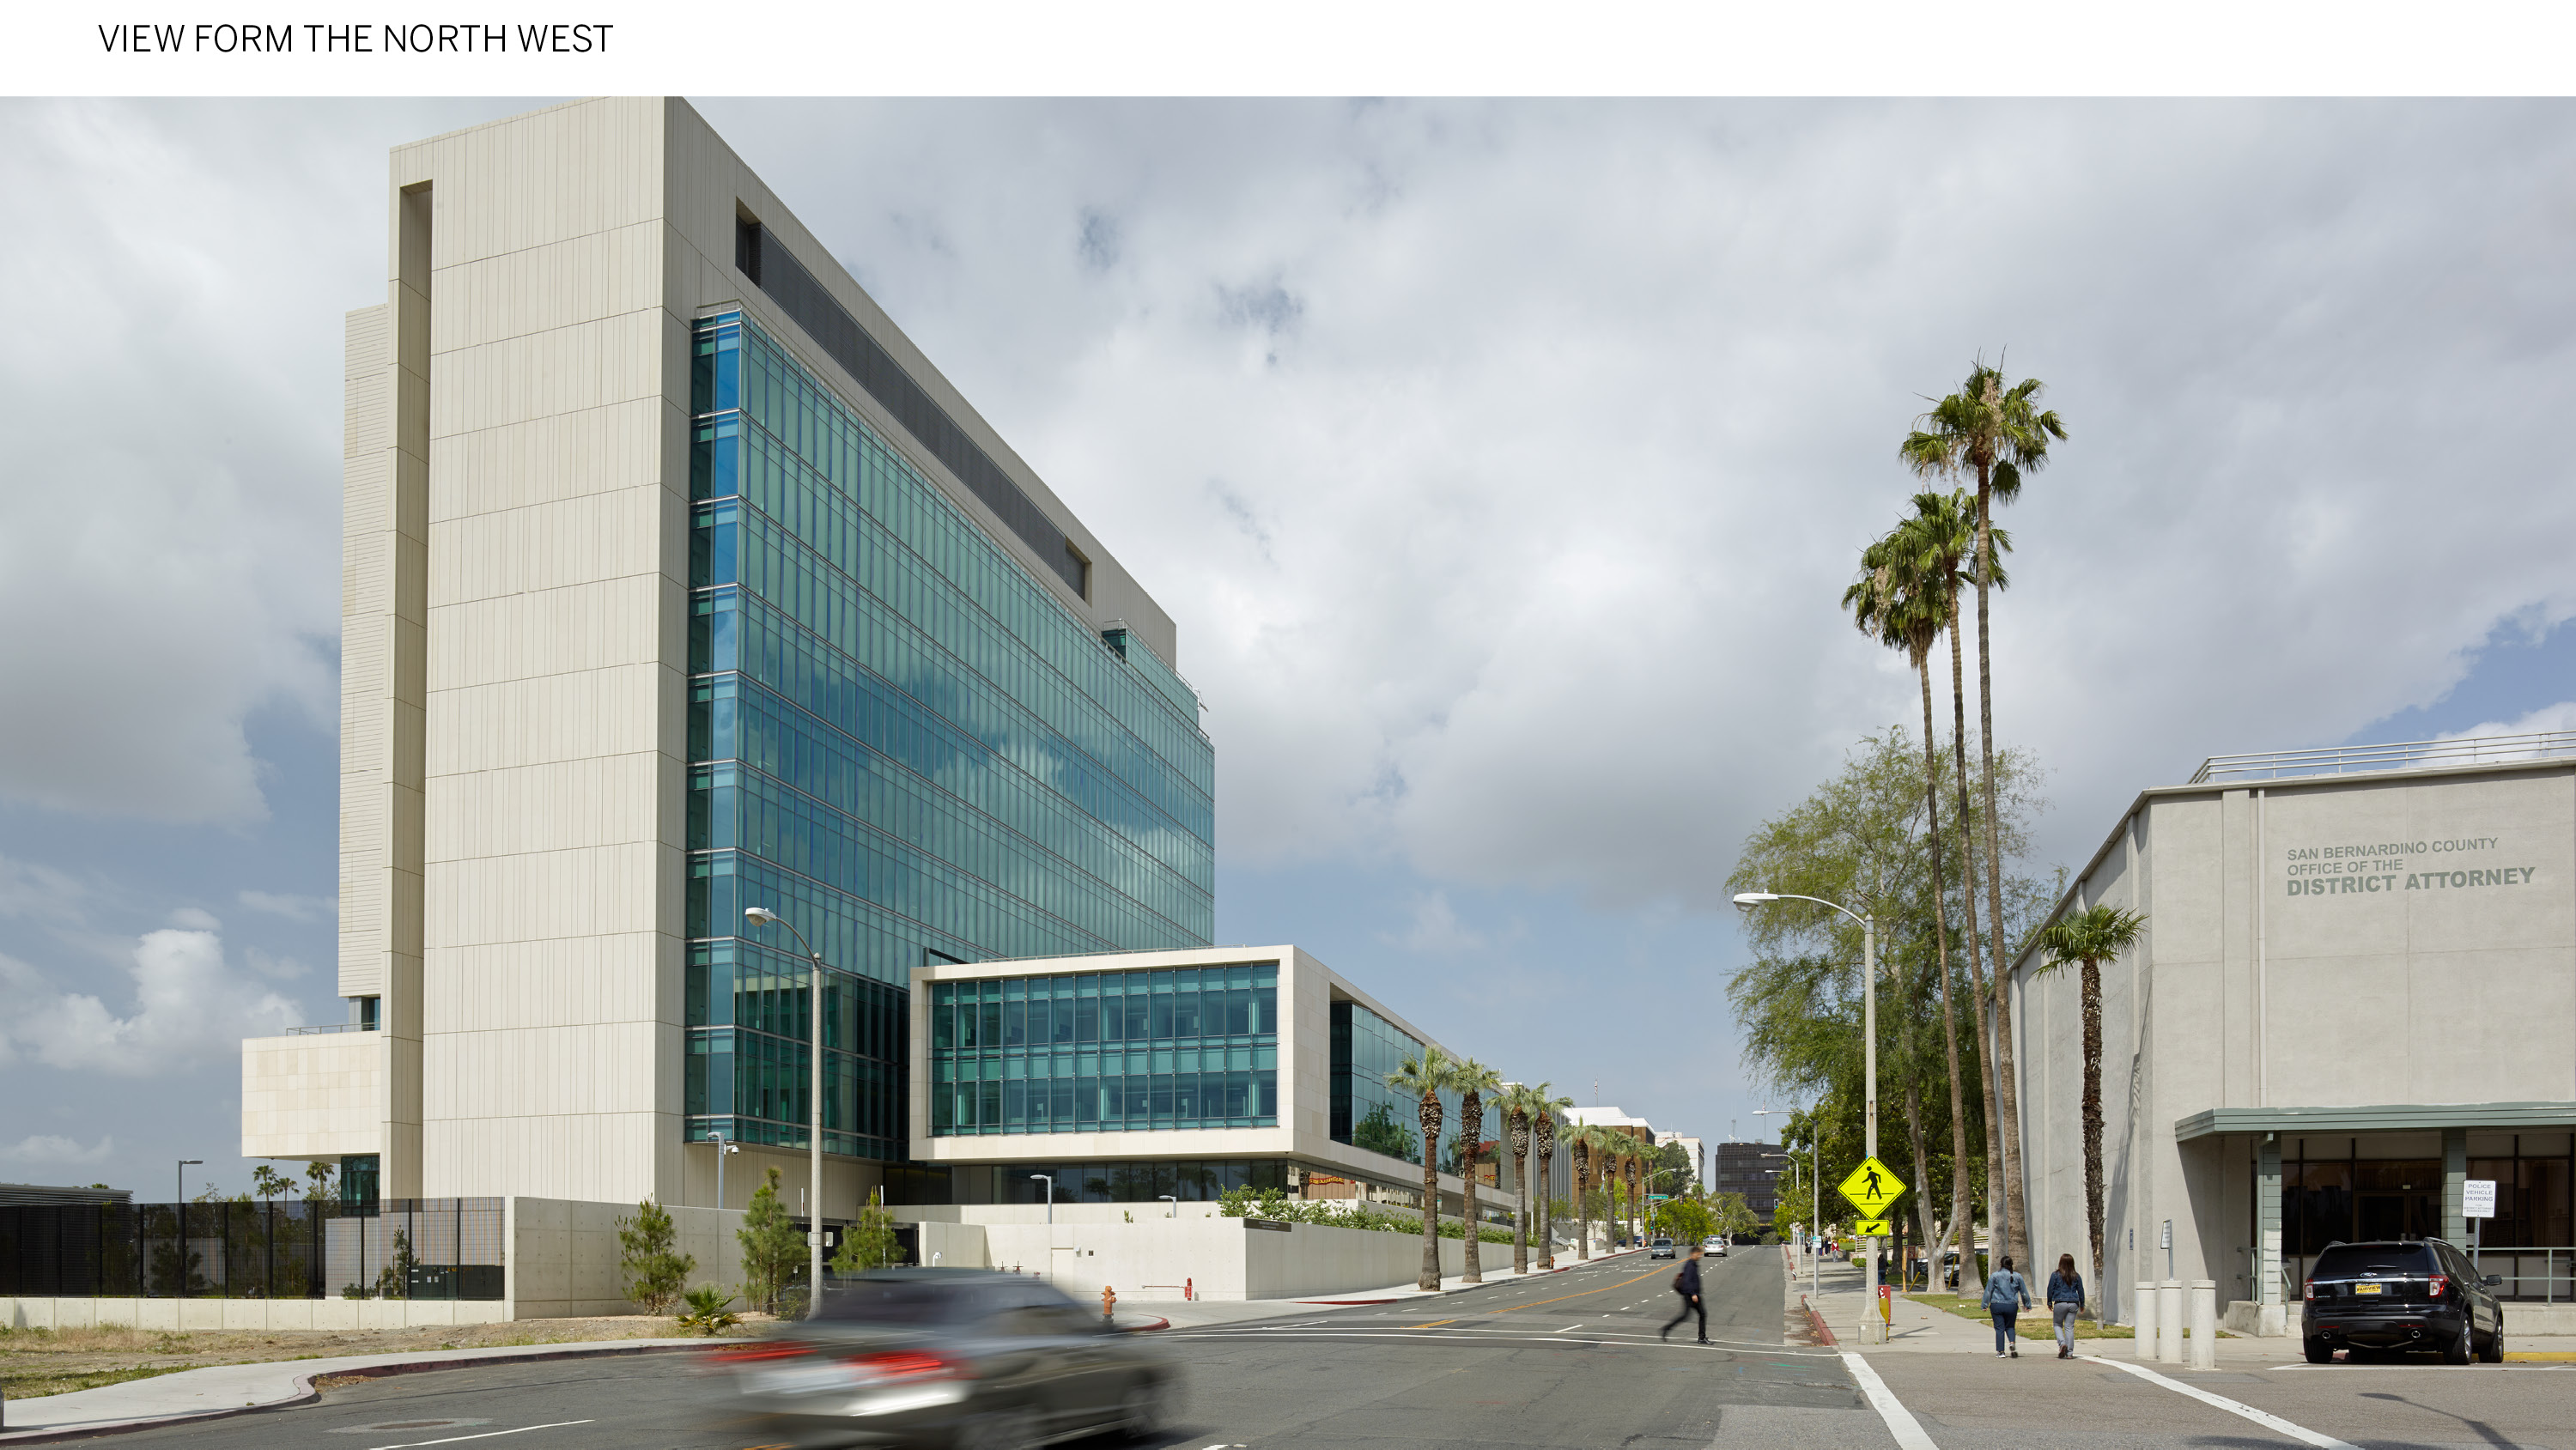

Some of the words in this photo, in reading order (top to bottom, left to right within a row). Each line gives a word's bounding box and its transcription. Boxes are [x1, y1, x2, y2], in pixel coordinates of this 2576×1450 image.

[2287, 847, 2319, 861] SAN
[2324, 840, 2427, 859] BERNARDINO
[2432, 837, 2499, 852] COUNTY
[2287, 862, 2342, 876] OFFICE
[2347, 860, 2368, 873] OF
[2372, 858, 2403, 871] THE
[2287, 874, 2397, 896] DISTRICT
[2404, 866, 2536, 889] ATTORNEY
